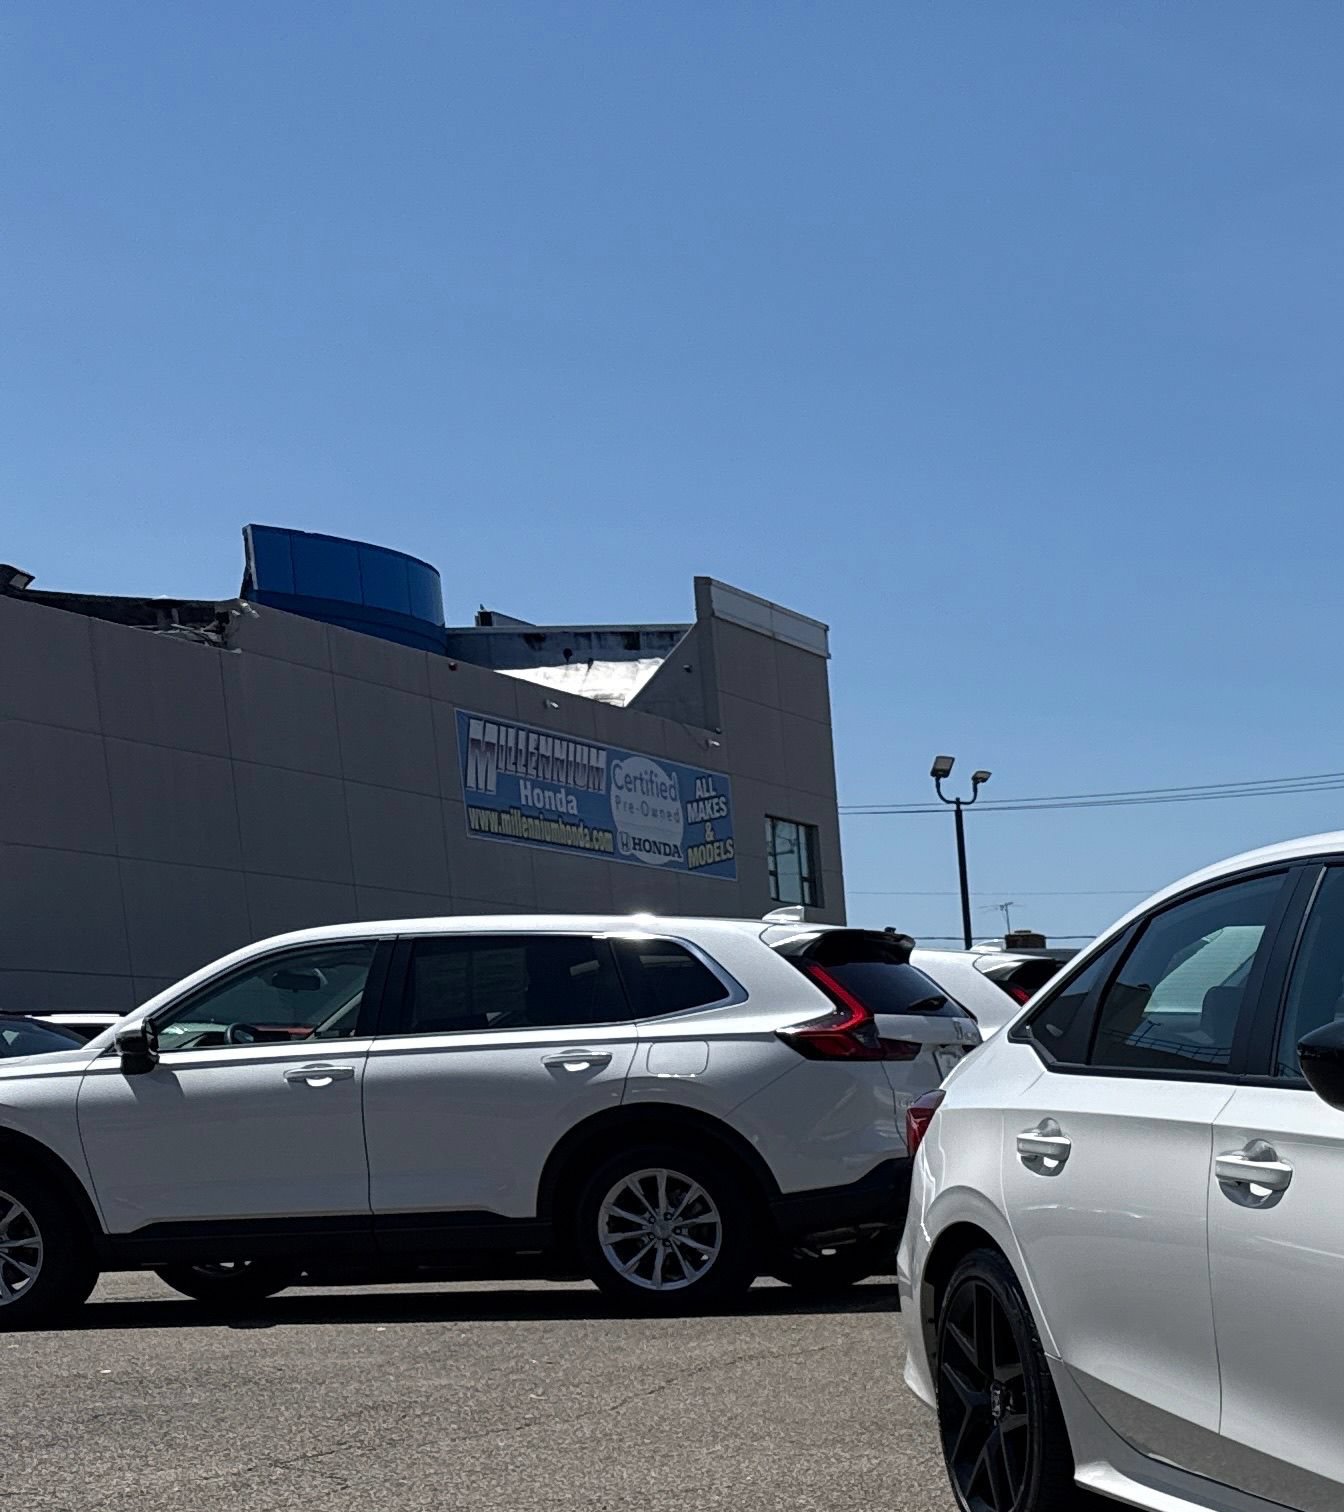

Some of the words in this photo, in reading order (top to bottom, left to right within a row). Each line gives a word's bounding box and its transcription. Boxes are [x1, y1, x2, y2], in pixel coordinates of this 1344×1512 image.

[466, 717, 607, 795] MILLENNIUM
[613, 763, 678, 801] Certified
[696, 777, 717, 800] ALL
[520, 779, 578, 816] Honda
[687, 796, 728, 824] MAKES
[468, 806, 614, 853] www.millenniumhonda.com
[704, 822, 715, 841] &
[632, 837, 683, 858] HONDA
[688, 839, 734, 869] MODELS
